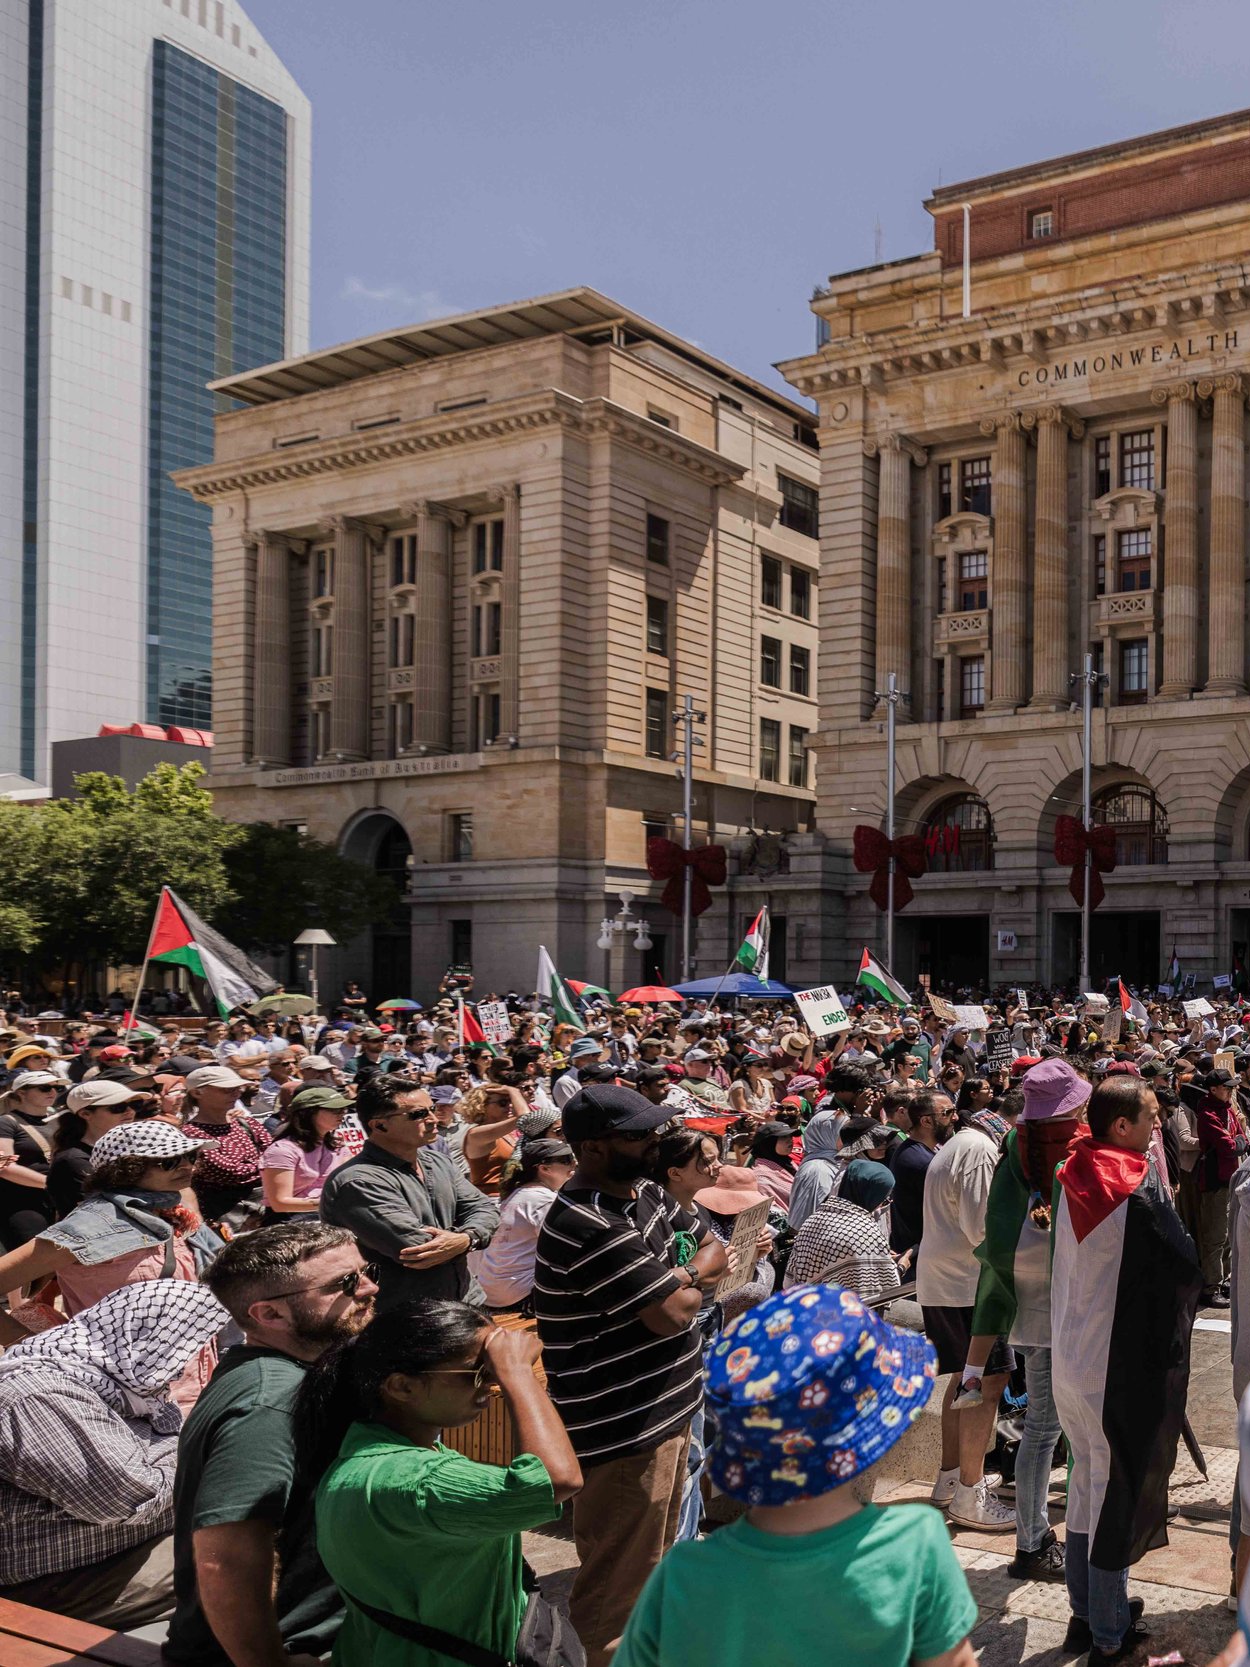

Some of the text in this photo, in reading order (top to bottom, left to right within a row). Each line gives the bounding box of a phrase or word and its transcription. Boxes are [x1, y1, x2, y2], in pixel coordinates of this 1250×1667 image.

[1018, 330, 1238, 387] COMMONWEALTH
[797, 992, 812, 1002] THE
[822, 1010, 847, 1026] ENDED
